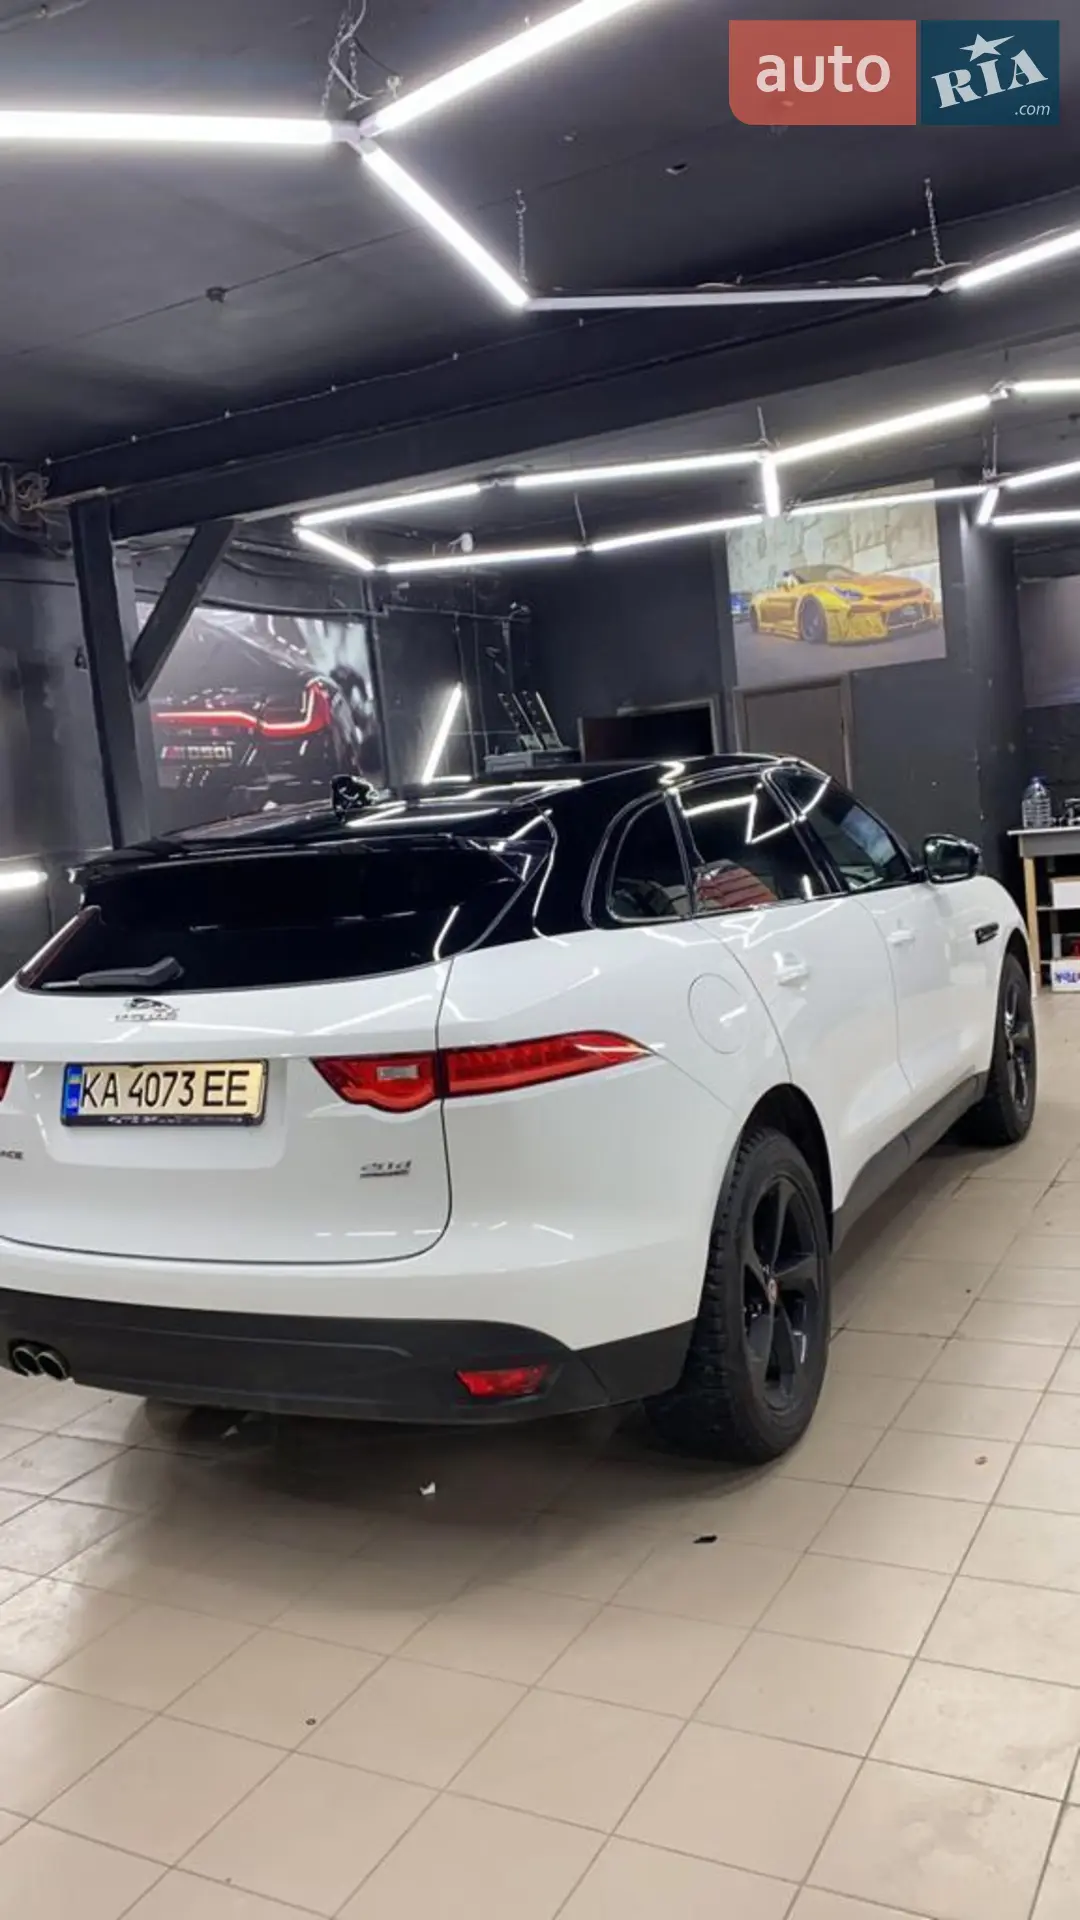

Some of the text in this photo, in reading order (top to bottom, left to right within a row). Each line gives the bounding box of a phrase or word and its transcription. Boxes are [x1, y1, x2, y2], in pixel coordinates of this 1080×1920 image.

[81, 1070, 250, 1108] KA 4073 EE
